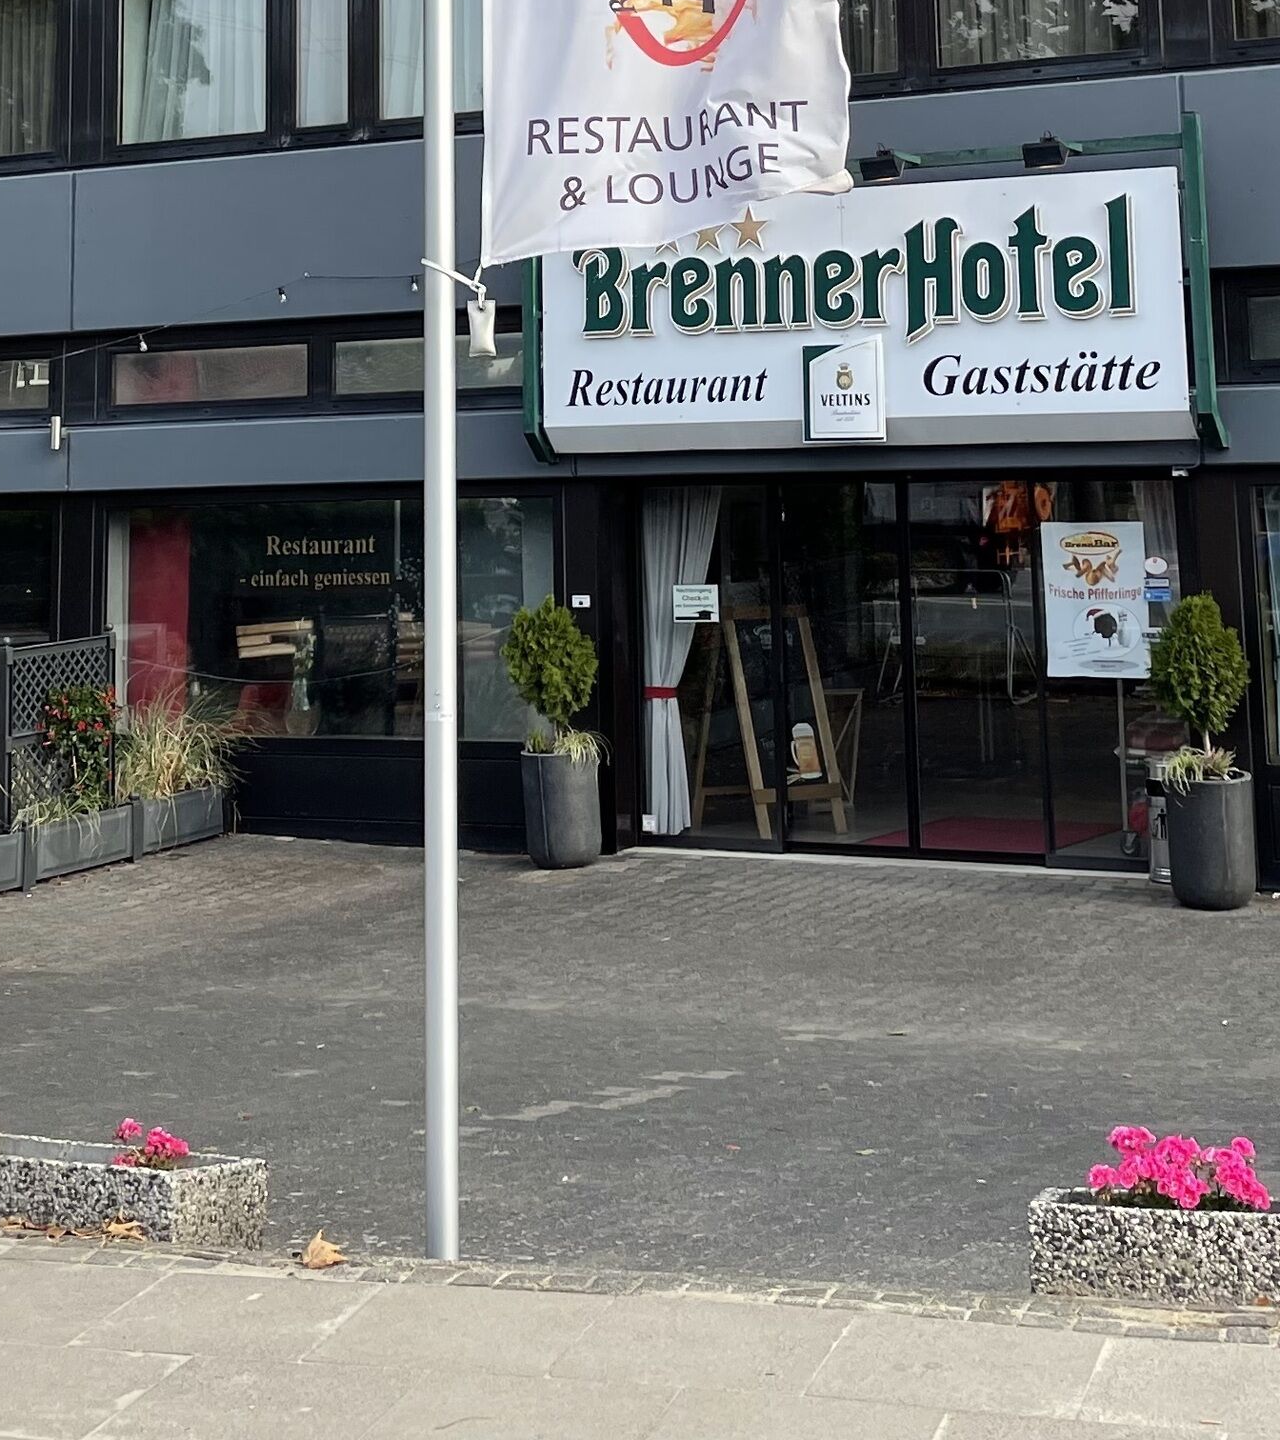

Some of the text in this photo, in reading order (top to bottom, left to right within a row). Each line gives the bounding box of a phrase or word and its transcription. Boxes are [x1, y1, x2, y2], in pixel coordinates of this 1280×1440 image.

[525, 100, 810, 156] RESTAURANT
[557, 142, 780, 212] & LOUNGE
[922, 351, 1162, 398] Gaststätte
[566, 366, 768, 408] Restaurant
[820, 392, 871, 407] VELTINS
[266, 534, 375, 556] Restaurant
[1064, 539, 1118, 548] BrennBar
[251, 569, 309, 587] einfach
[314, 568, 391, 591] geniessen
[1048, 583, 1085, 600] Frische
